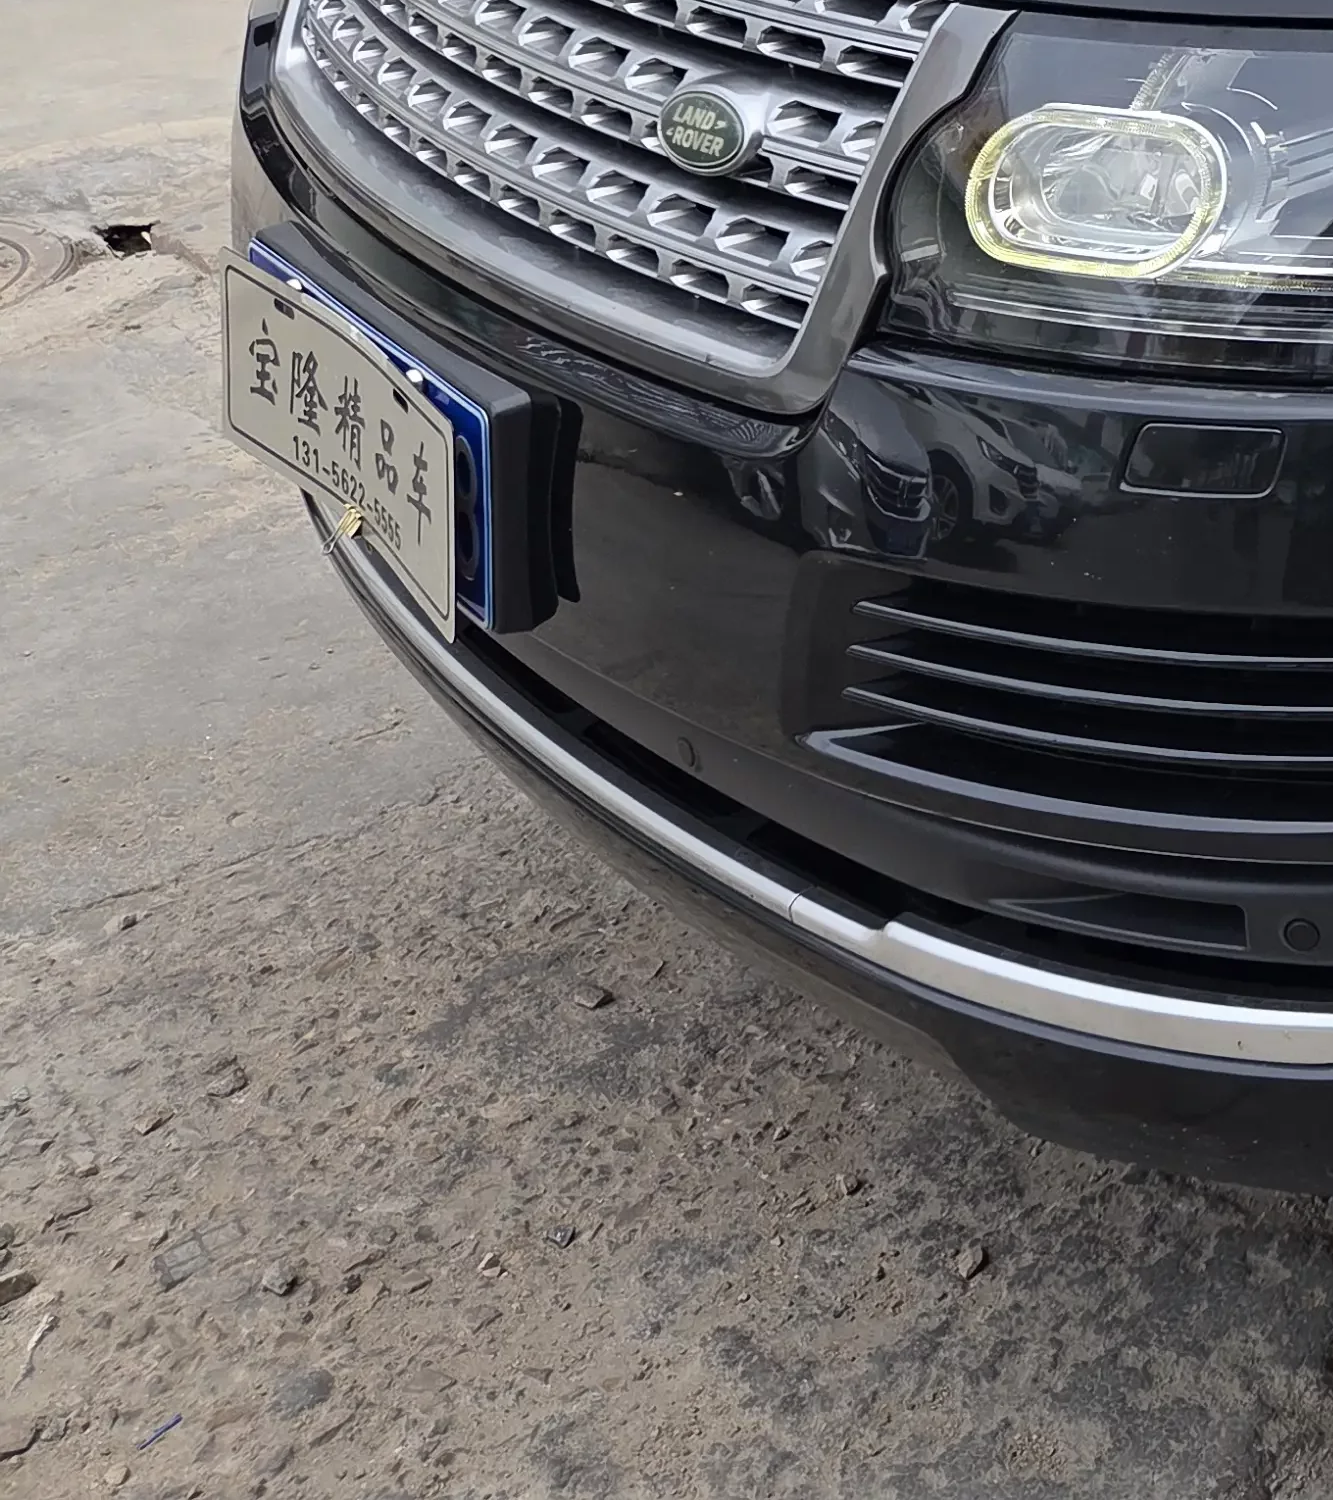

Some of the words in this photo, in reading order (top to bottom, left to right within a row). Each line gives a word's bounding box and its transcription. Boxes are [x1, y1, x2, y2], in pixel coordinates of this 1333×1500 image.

[671, 126, 725, 157] ROVER
[672, 102, 717, 131] LAND
[248, 318, 433, 547] 宝隆精品车
[292, 435, 403, 551] 131-5622-5555
